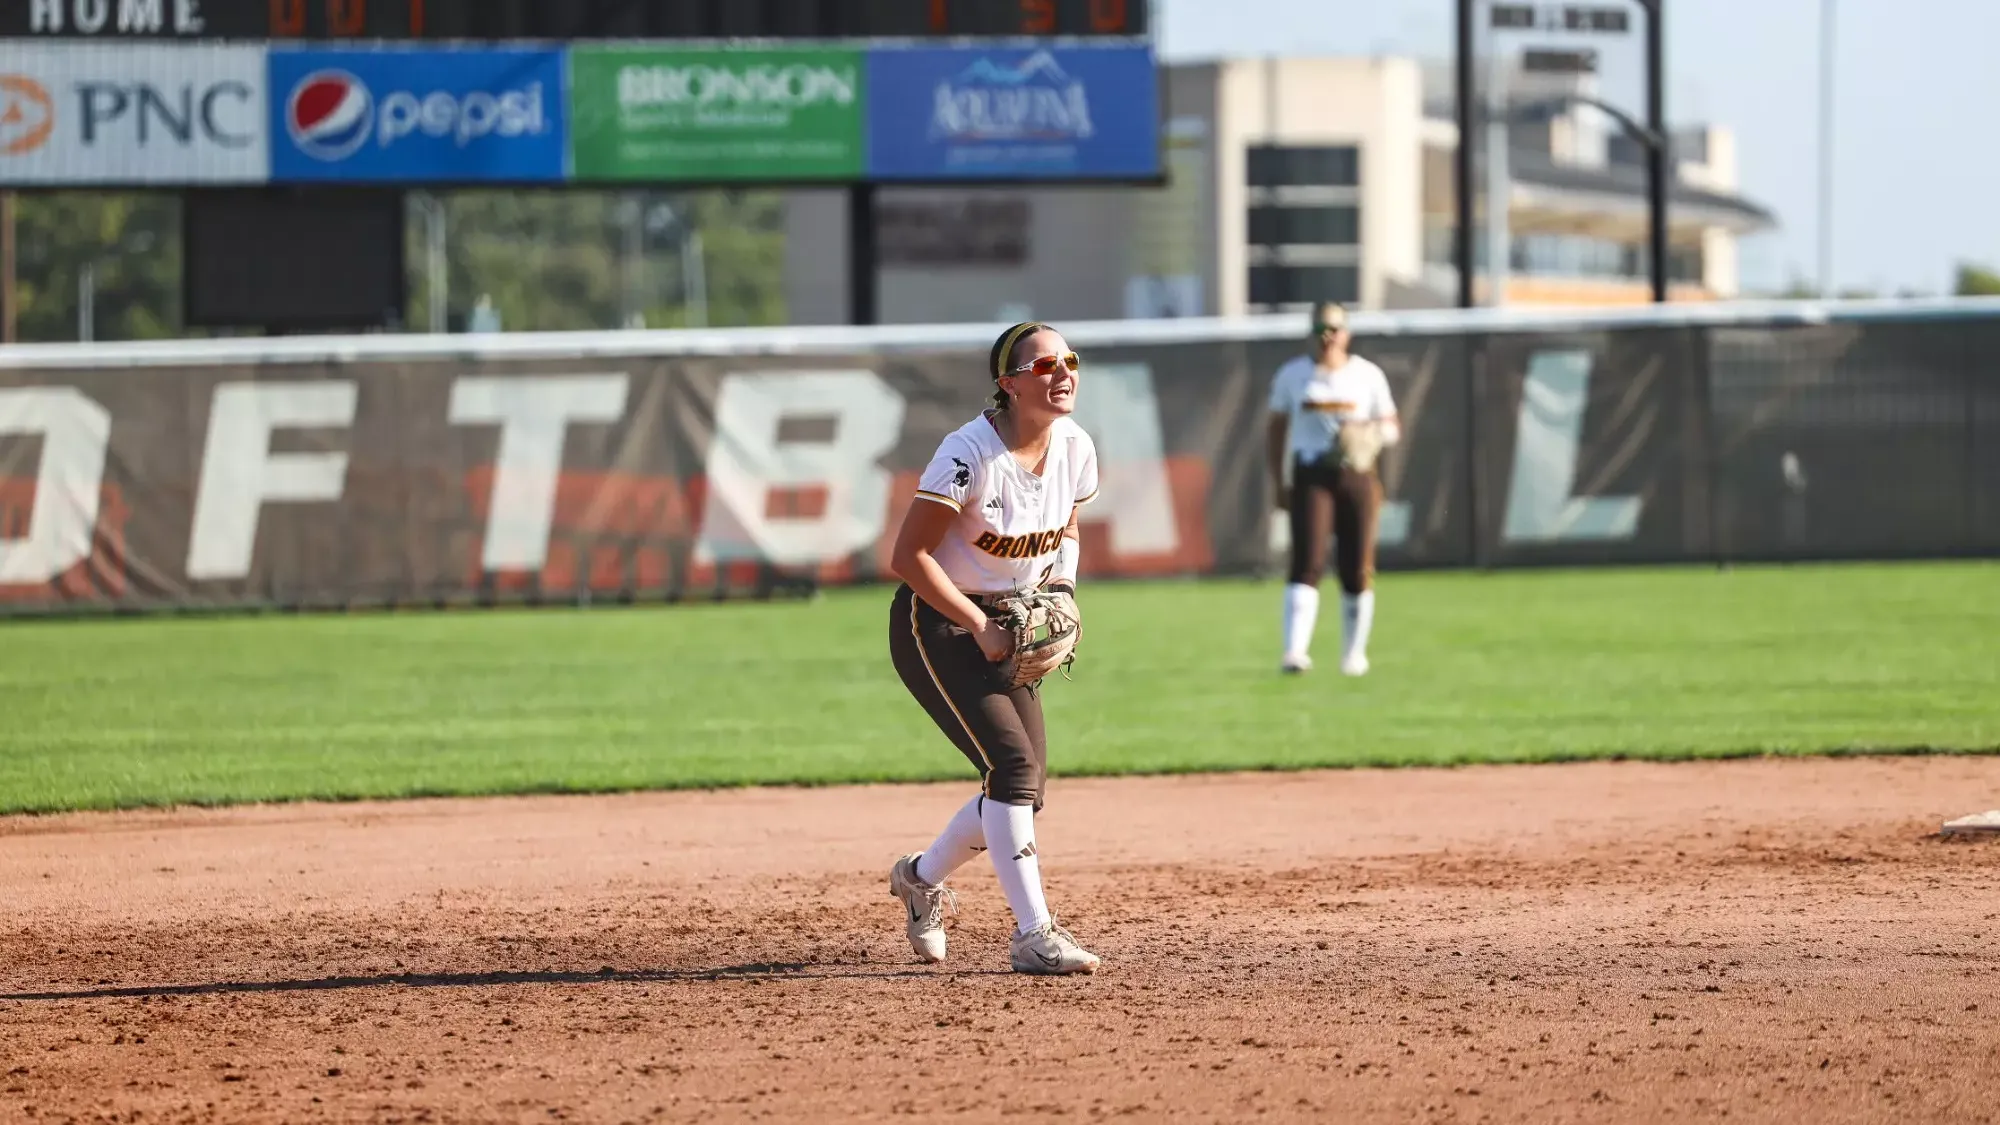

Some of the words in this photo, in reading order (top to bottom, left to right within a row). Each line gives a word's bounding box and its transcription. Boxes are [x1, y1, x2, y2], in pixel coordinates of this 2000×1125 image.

[30, 0, 206, 34] HOME
[73, 80, 254, 148] PNC
[378, 81, 543, 149] pepsi
